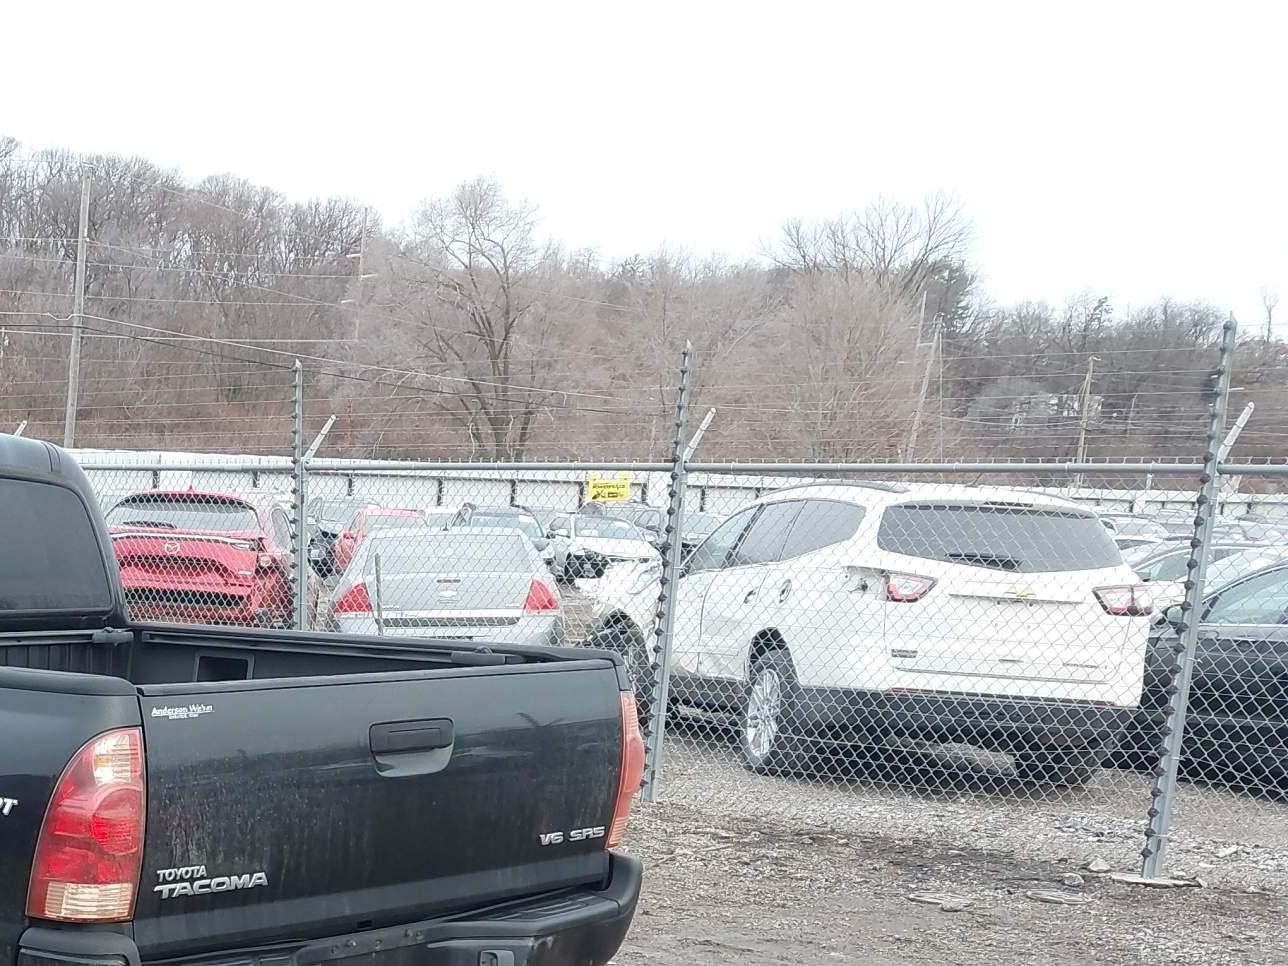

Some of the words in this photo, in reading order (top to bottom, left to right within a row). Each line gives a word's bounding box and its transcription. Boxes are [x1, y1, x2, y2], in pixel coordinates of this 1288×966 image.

[539, 831, 564, 846] V6
[568, 825, 605, 842] SR5
[156, 865, 207, 882] TOYOTA
[153, 872, 268, 899] TACOMA
